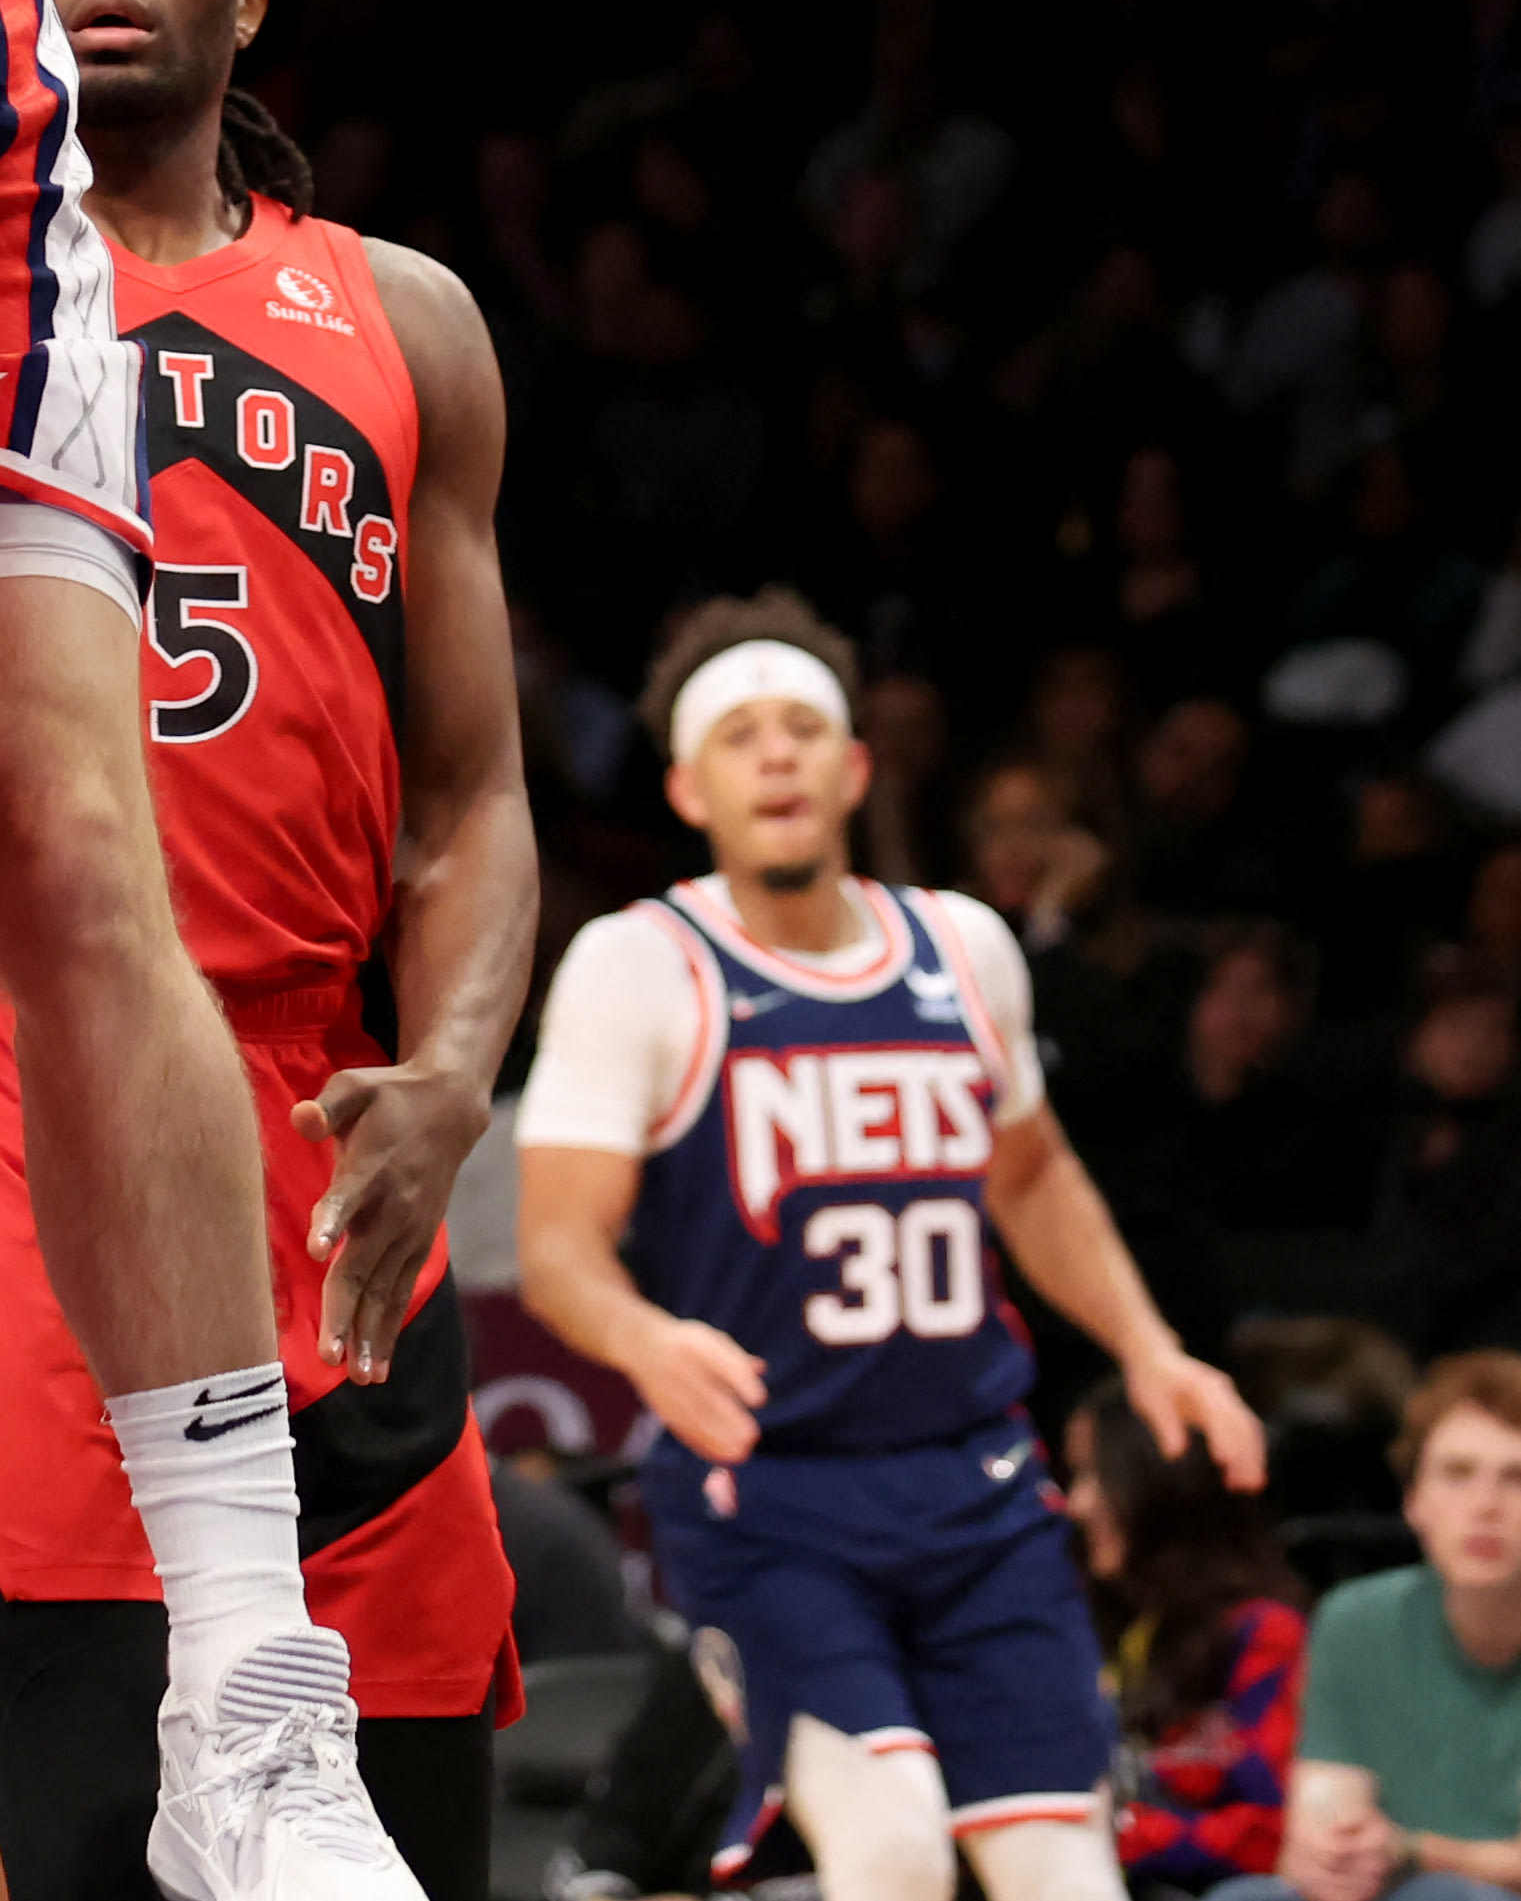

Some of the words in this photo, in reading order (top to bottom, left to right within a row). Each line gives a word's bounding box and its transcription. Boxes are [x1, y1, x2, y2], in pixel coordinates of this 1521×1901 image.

[265, 300, 312, 325] Sun
[313, 310, 356, 337] Life
[148, 562, 258, 743] 5
[727, 1042, 993, 1245] NETS
[804, 1198, 985, 1346] 30
